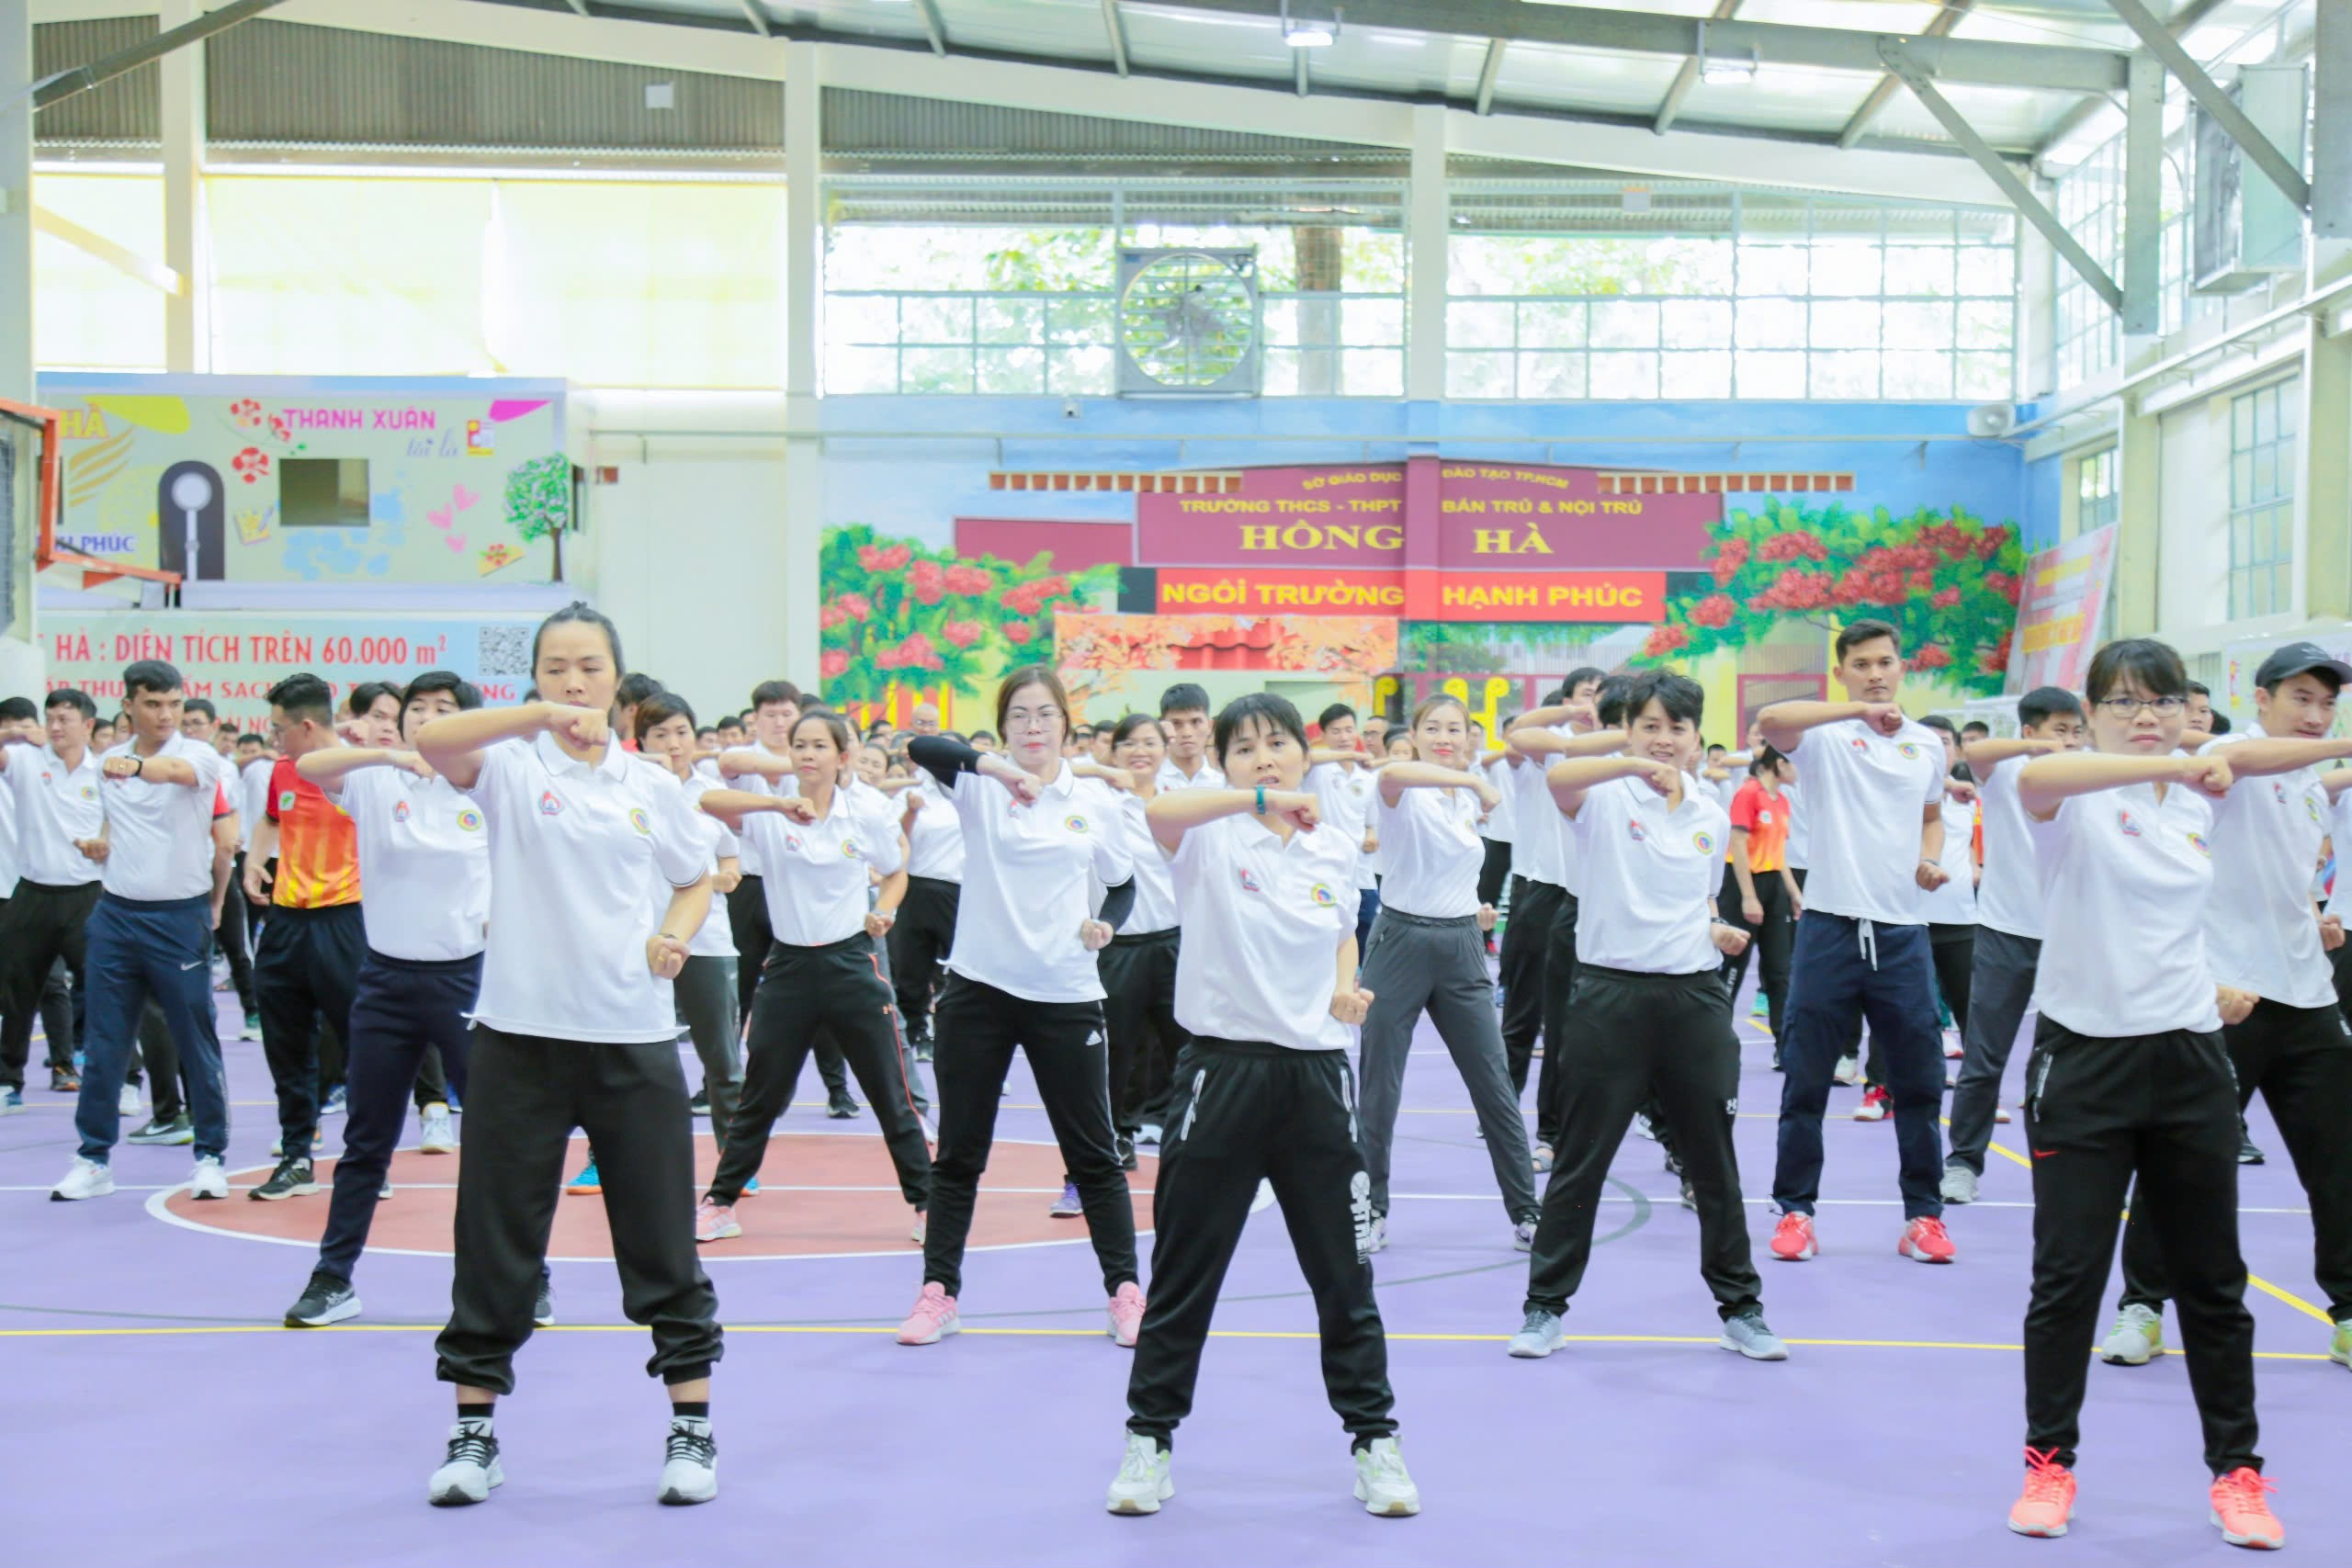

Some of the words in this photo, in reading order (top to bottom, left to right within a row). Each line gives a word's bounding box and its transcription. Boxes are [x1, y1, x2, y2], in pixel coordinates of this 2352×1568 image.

[283, 410, 363, 429] THANH
[373, 406, 435, 429] XUÂN
[1276, 500, 1330, 512] THCS
[1350, 500, 1402, 513] THPT
[1538, 502, 1554, 513] &
[81, 532, 135, 552] PHÚC
[1473, 521, 1554, 554] HÀ
[1442, 585, 1538, 609] HẠNH
[1548, 583, 1643, 606] PHÚC
[181, 628, 239, 662] TÍCH
[250, 630, 312, 663] TRÊN
[322, 637, 408, 665] 60.000
